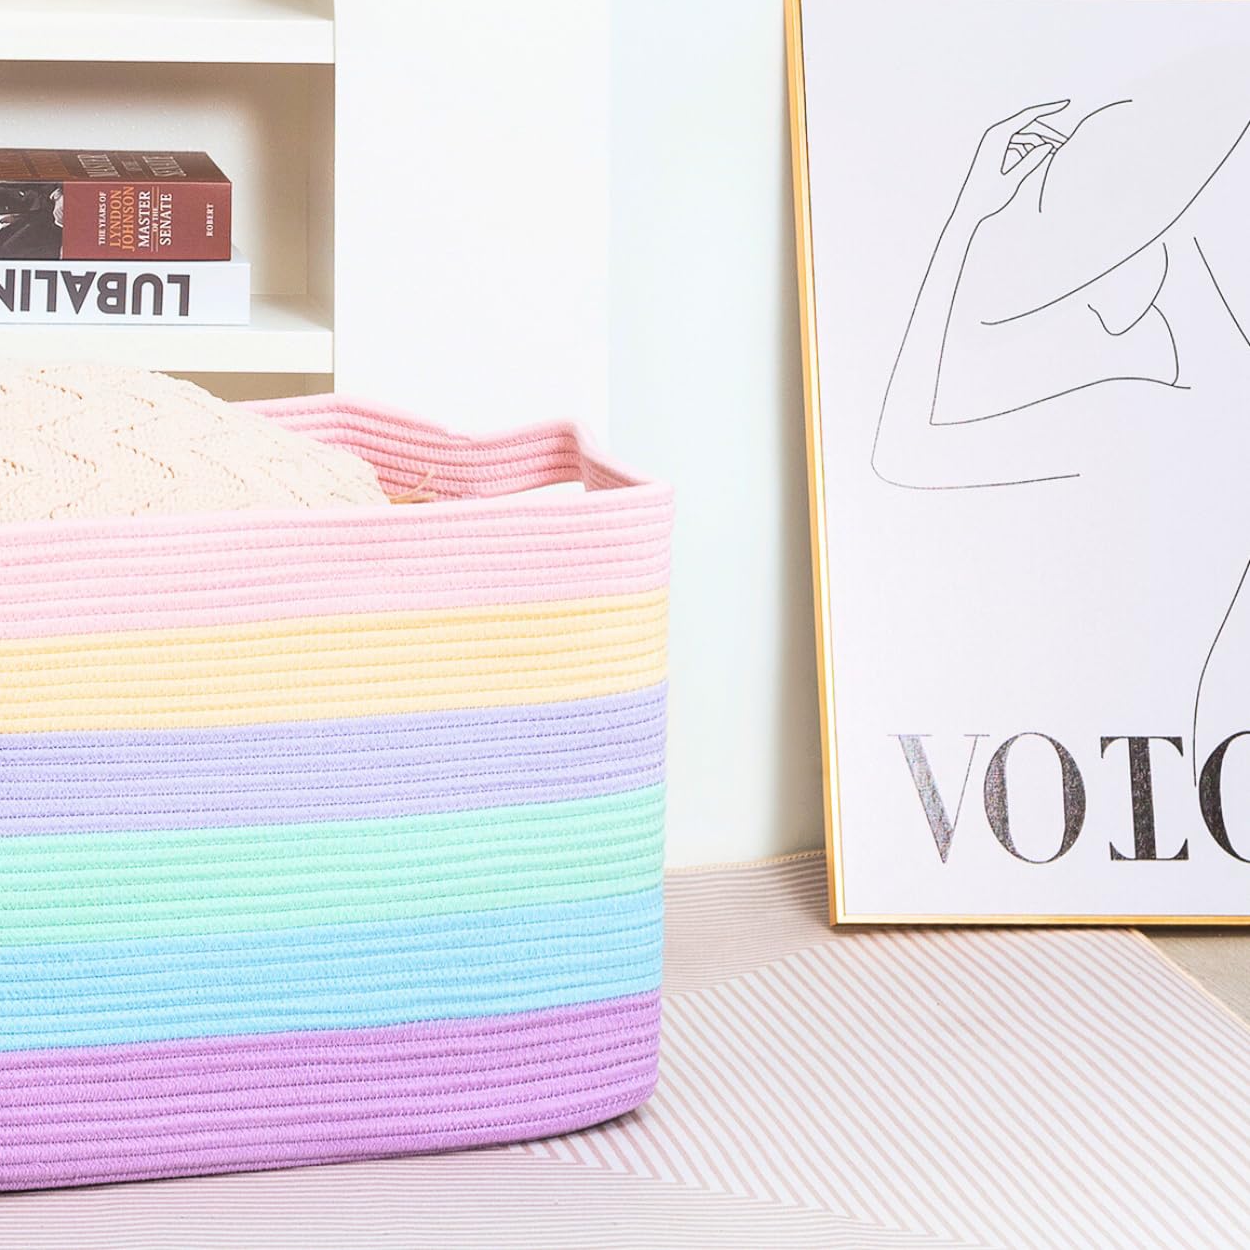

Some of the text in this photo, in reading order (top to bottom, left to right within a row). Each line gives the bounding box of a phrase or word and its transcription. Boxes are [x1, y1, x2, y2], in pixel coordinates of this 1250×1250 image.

[98, 191, 107, 245] THE YEARS OF
[109, 189, 122, 247] LYNDON
[123, 186, 135, 252] JOHNSON
[138, 191, 151, 248] MASTER
[159, 193, 172, 246] SENATE
[206, 203, 214, 237] ROBERT
